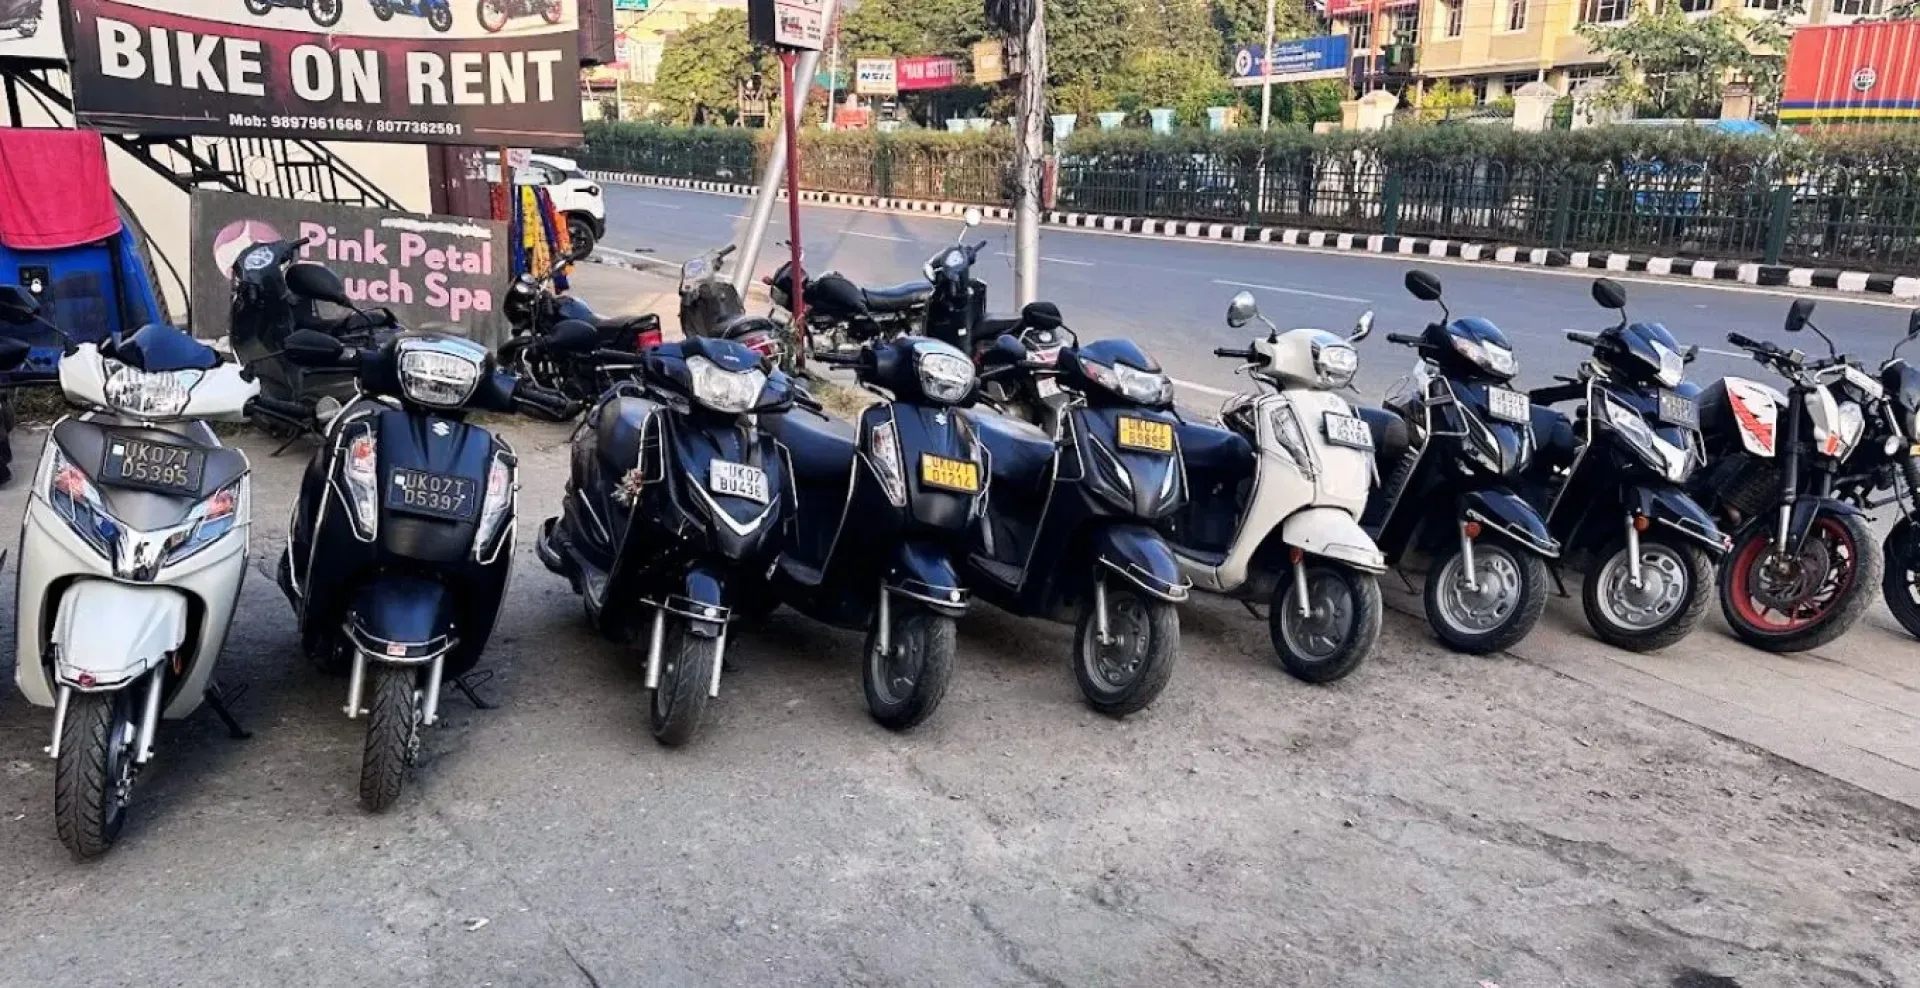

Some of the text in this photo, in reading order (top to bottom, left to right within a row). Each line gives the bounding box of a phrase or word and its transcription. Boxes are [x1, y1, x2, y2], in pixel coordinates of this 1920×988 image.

[96, 17, 563, 105] BIKE ON RENT
[228, 113, 267, 128] Mob:
[366, 120, 373, 133] /
[300, 221, 492, 275] Pink Petal
[425, 272, 492, 322] Spa
[124, 441, 193, 467] UK07T
[405, 473, 466, 495] UK07T
[729, 464, 761, 483] UK07
[404, 489, 464, 512] D5397
